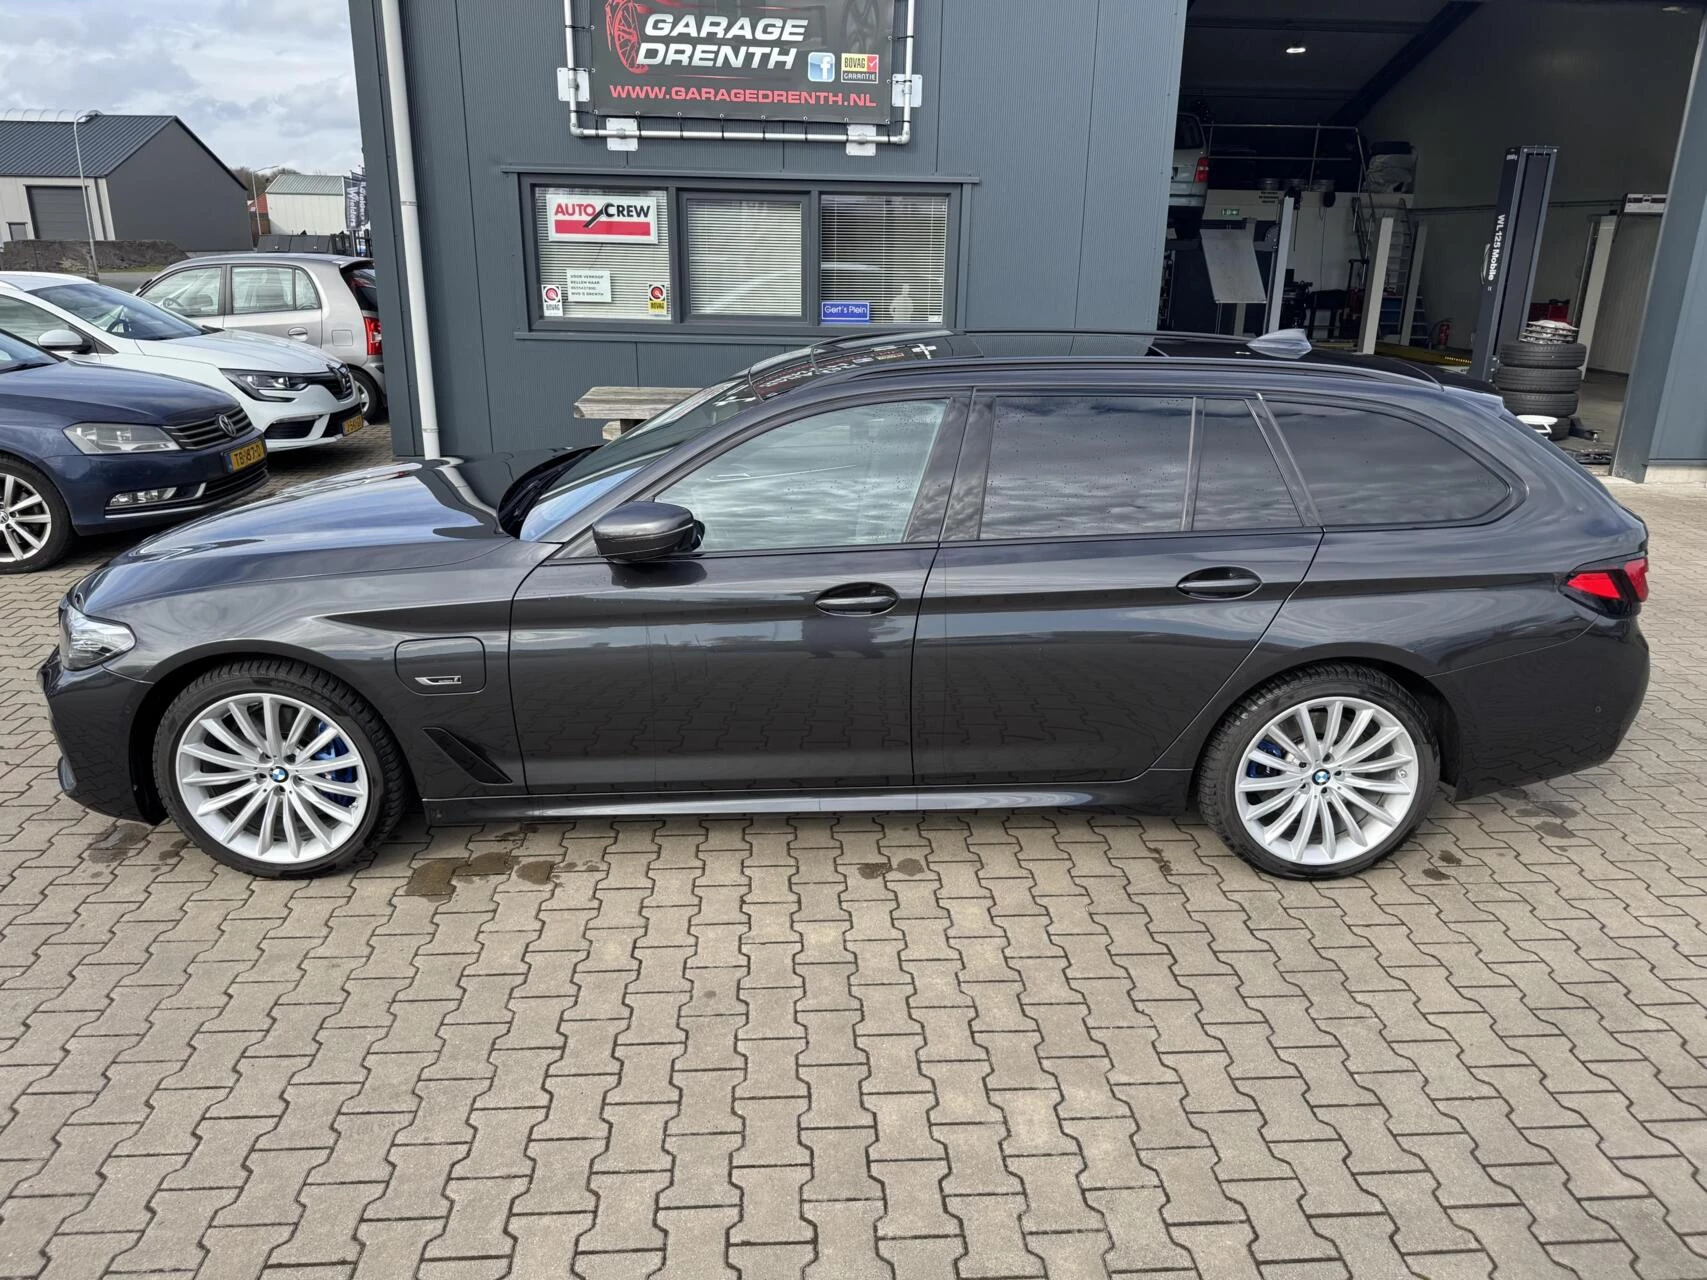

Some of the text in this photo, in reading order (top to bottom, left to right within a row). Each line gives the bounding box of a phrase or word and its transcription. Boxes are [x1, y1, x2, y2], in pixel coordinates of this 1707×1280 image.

[644, 13, 809, 42] GARAGE
[636, 42, 798, 70] DRENTH
[844, 57, 866, 69] BOVAG
[843, 73, 876, 81] GARANTIE
[609, 84, 877, 108] WWW.GARAGEDRENTH.NL
[554, 202, 651, 218] AUTO CREW
[1495, 214, 1506, 231] WL
[1493, 231, 1503, 249] 125
[1488, 248, 1500, 281] Mobile
[650, 302, 665, 310] BOVAG
[824, 305, 867, 314] Gert's Plein
